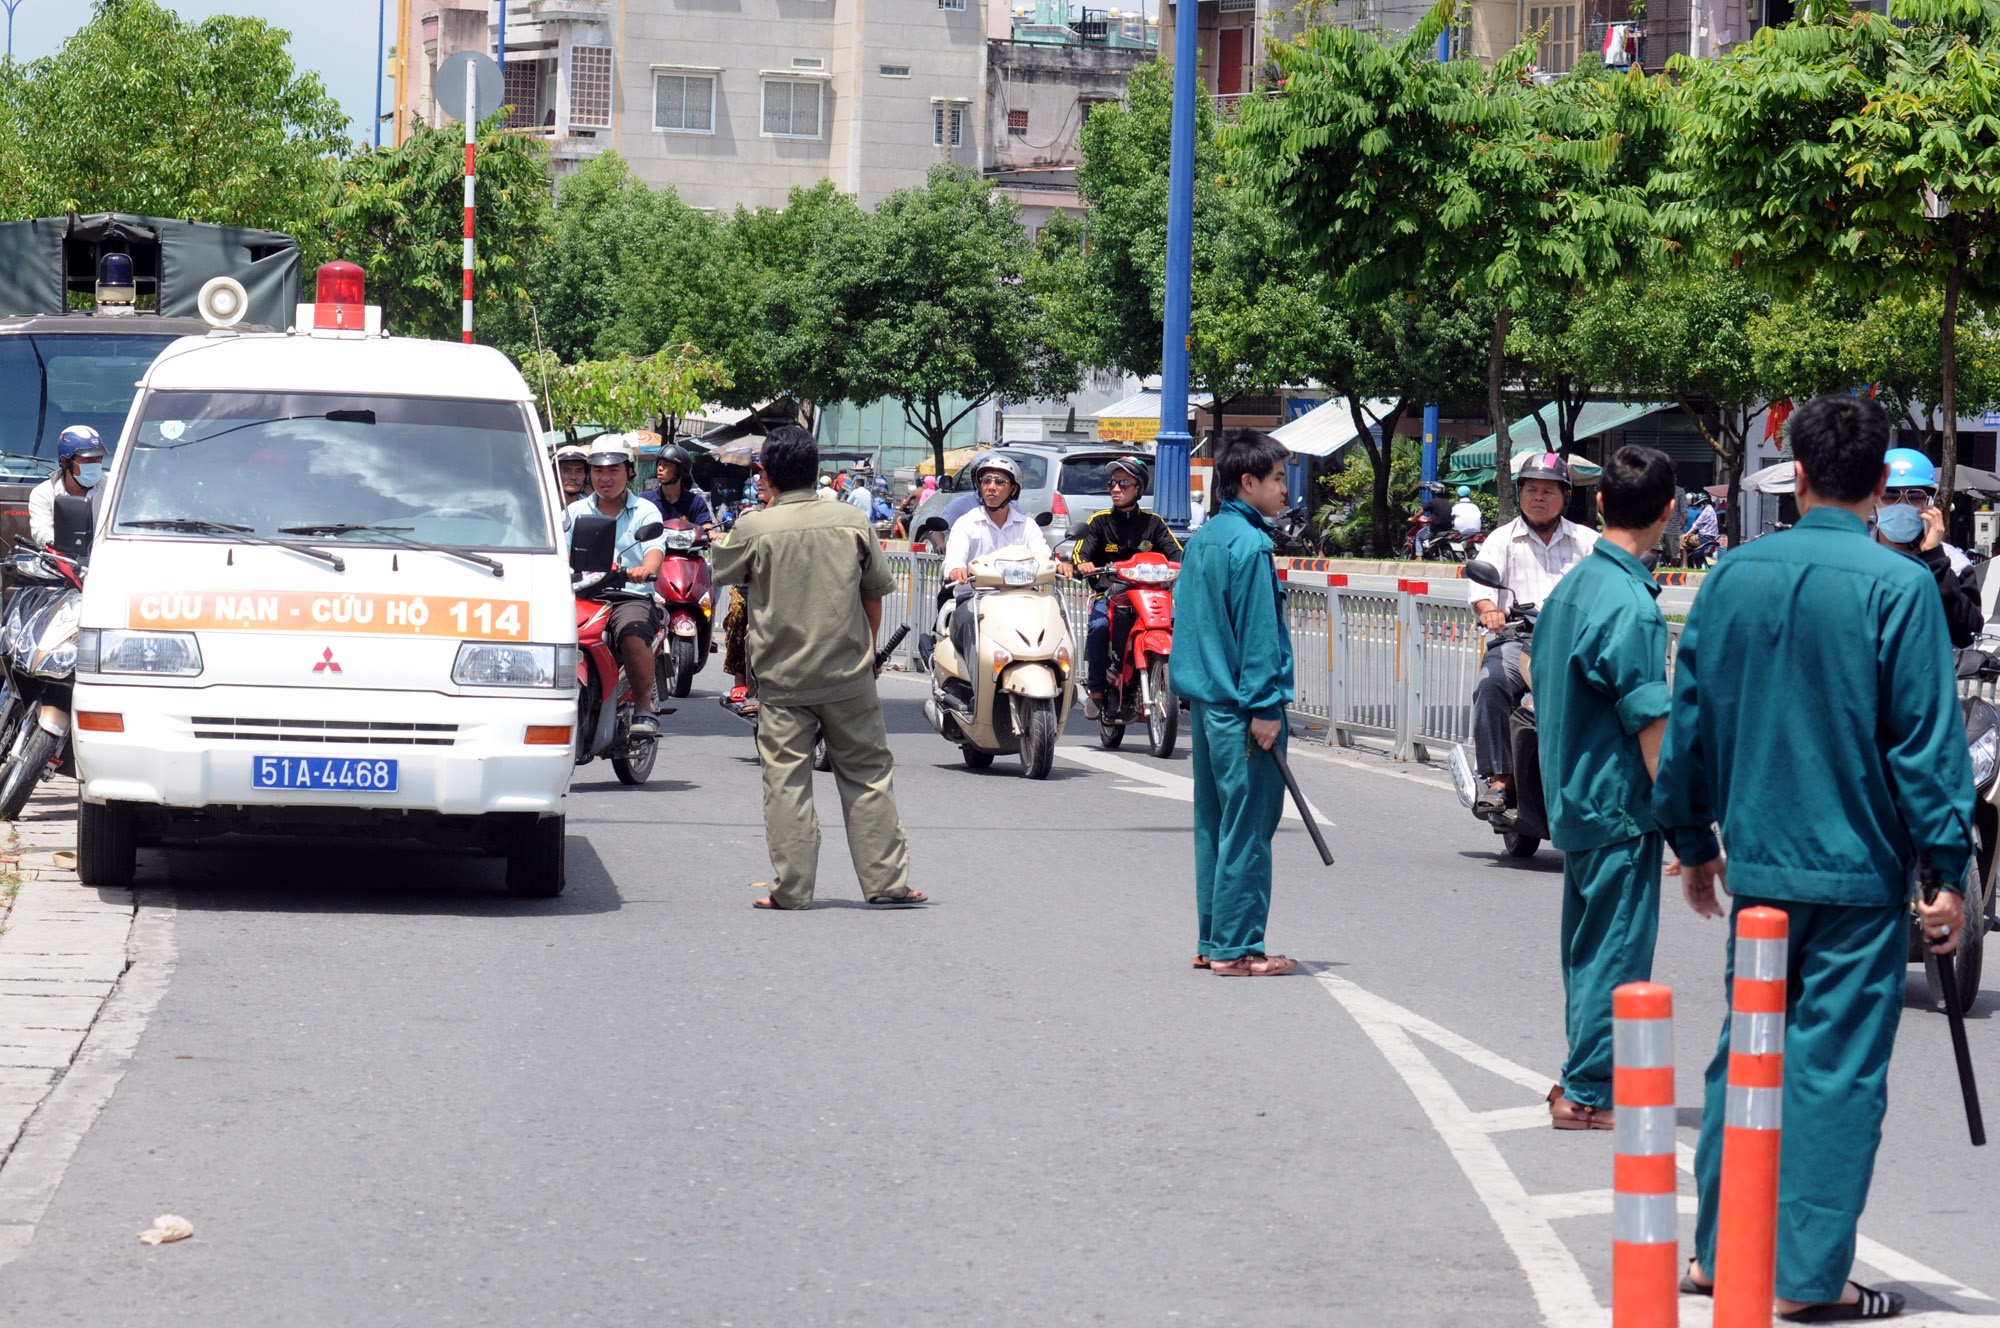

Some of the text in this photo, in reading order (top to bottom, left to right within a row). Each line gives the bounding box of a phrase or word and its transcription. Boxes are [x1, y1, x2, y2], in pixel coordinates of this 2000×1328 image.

[140, 591, 202, 620] CỨU
[214, 596, 278, 627] NẠN
[311, 593, 374, 624] CỨU
[386, 596, 429, 633] HỘ
[449, 601, 521, 636] 114
[261, 758, 389, 788] 51A-4468
